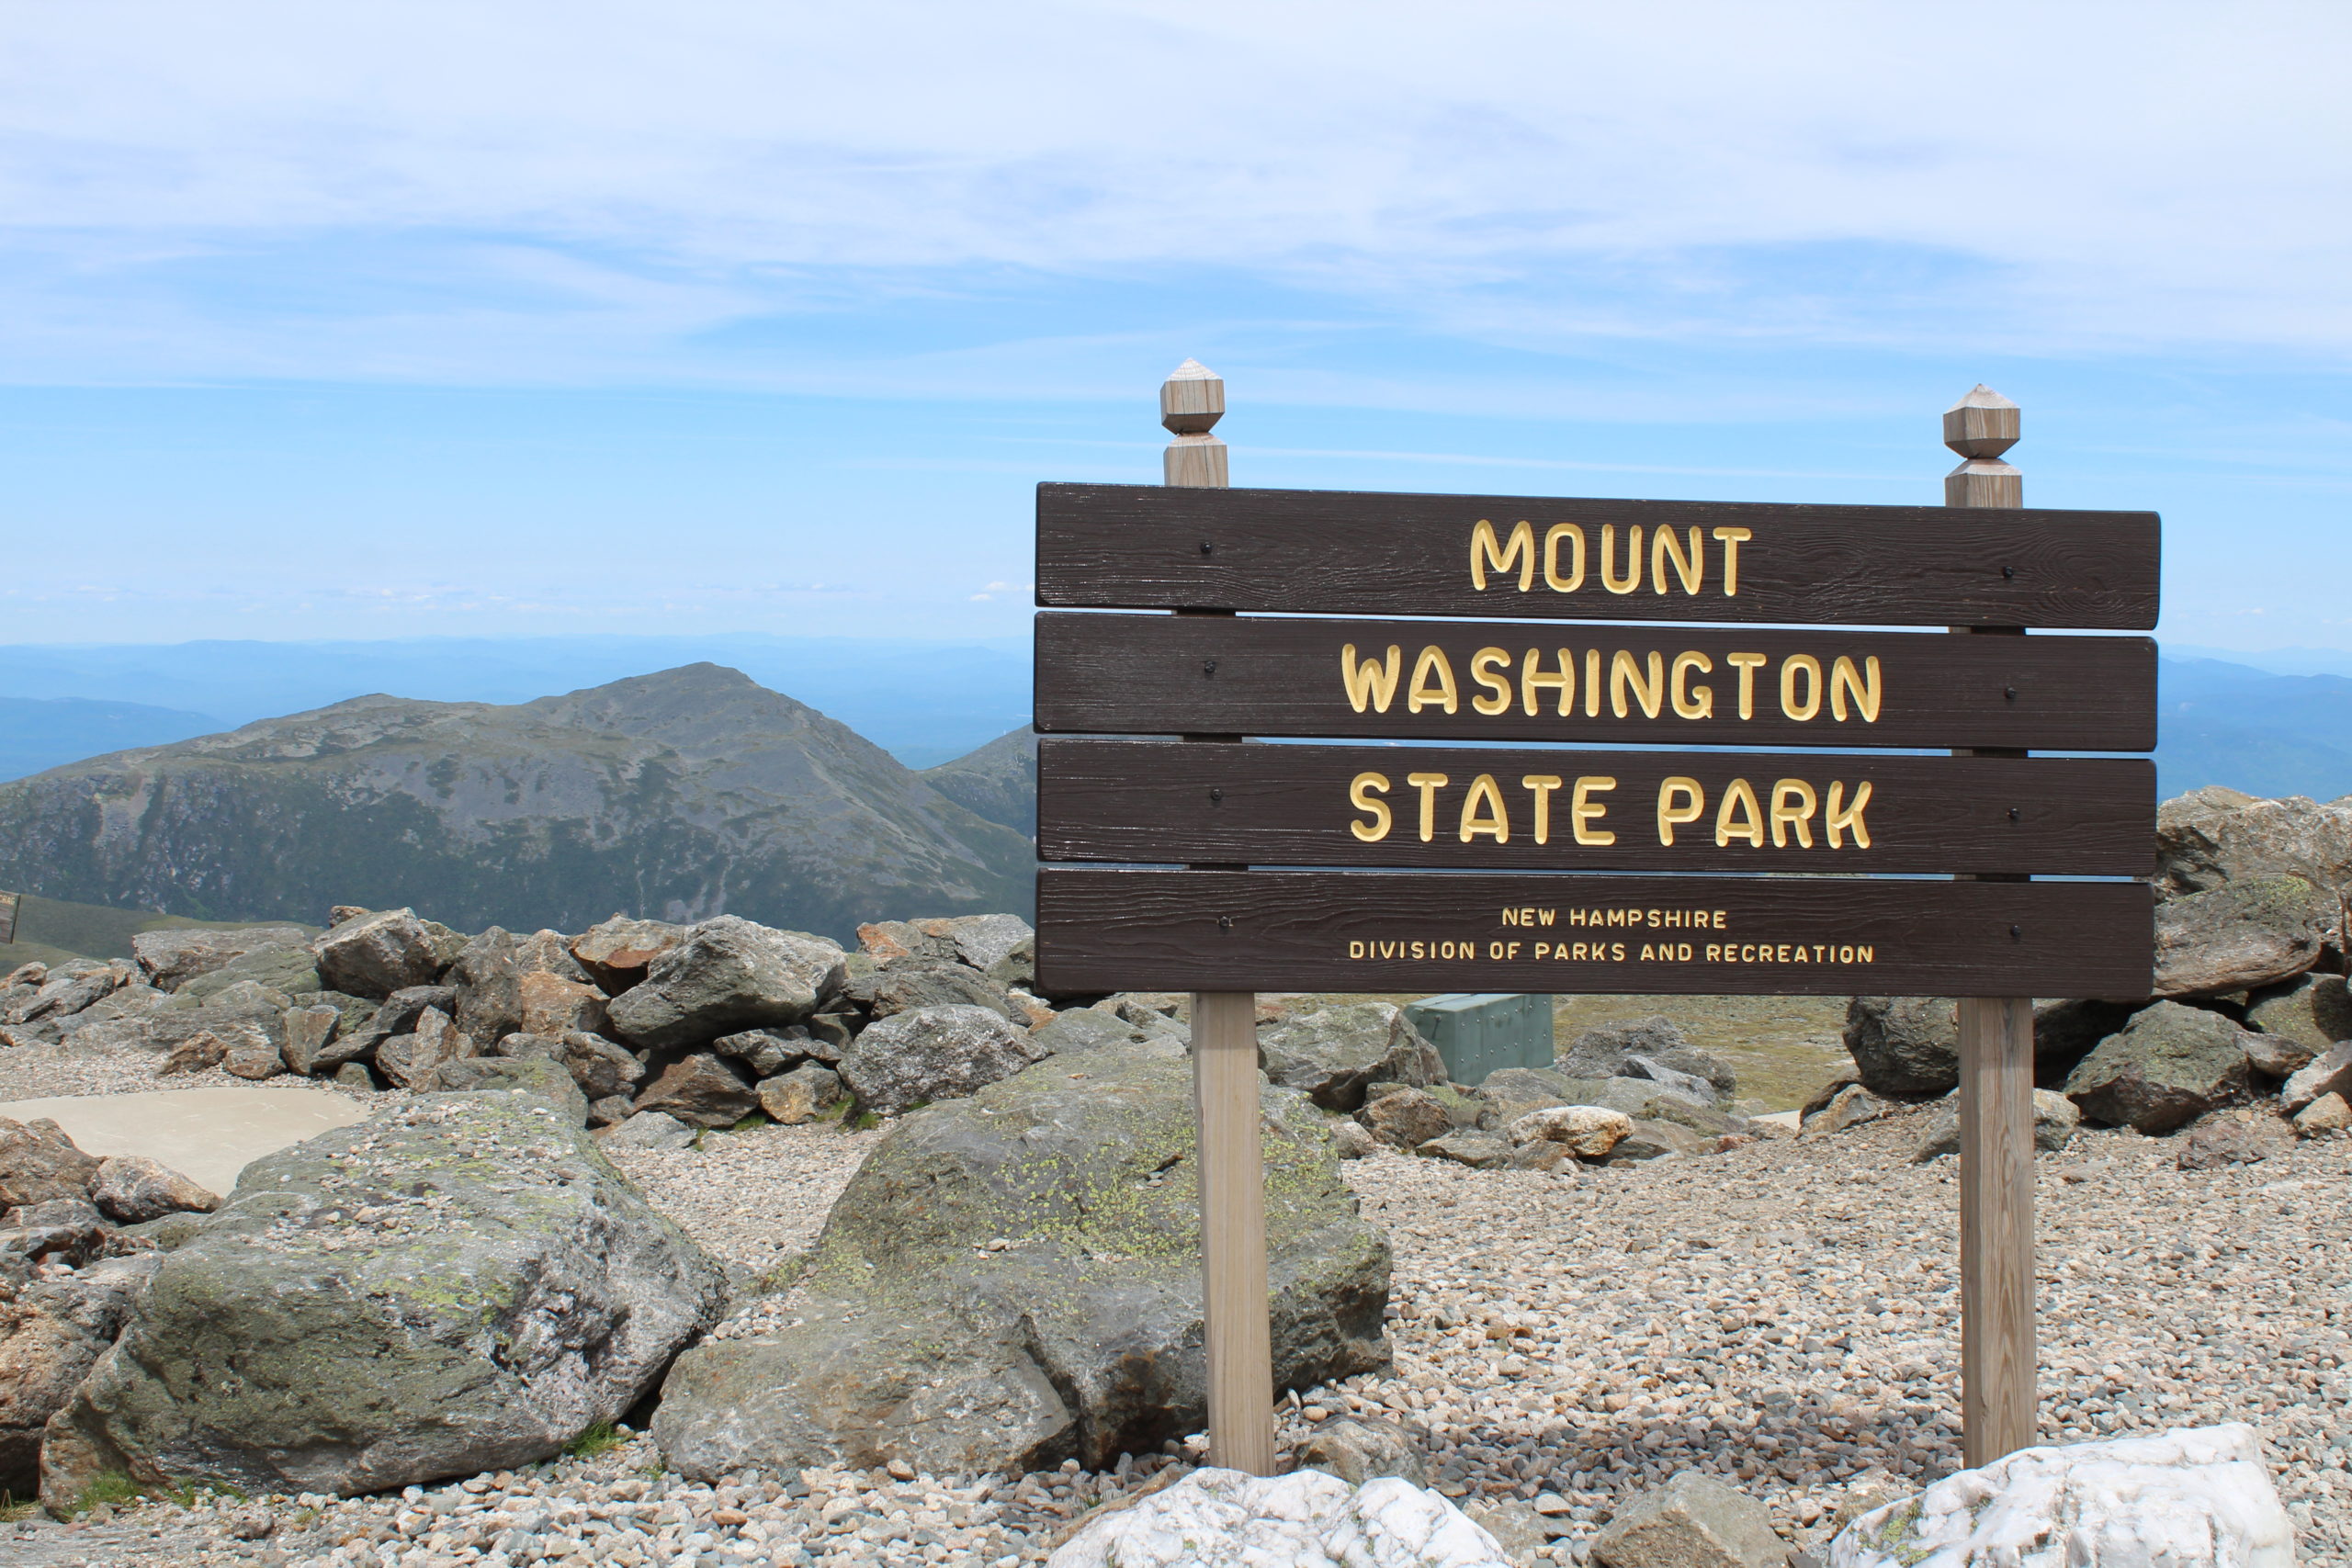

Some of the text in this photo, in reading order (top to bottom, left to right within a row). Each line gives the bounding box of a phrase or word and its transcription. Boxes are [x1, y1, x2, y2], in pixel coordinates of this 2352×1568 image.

[1470, 519, 1753, 597] MOUNT
[1340, 643, 1882, 723] WASHINGTON
[1350, 772, 1873, 851] STATE PARK
[1349, 941, 1874, 964] DIVISION OF PARKS AND RECREATION
[1501, 908, 1728, 929] NEW HAMPSHIRE
